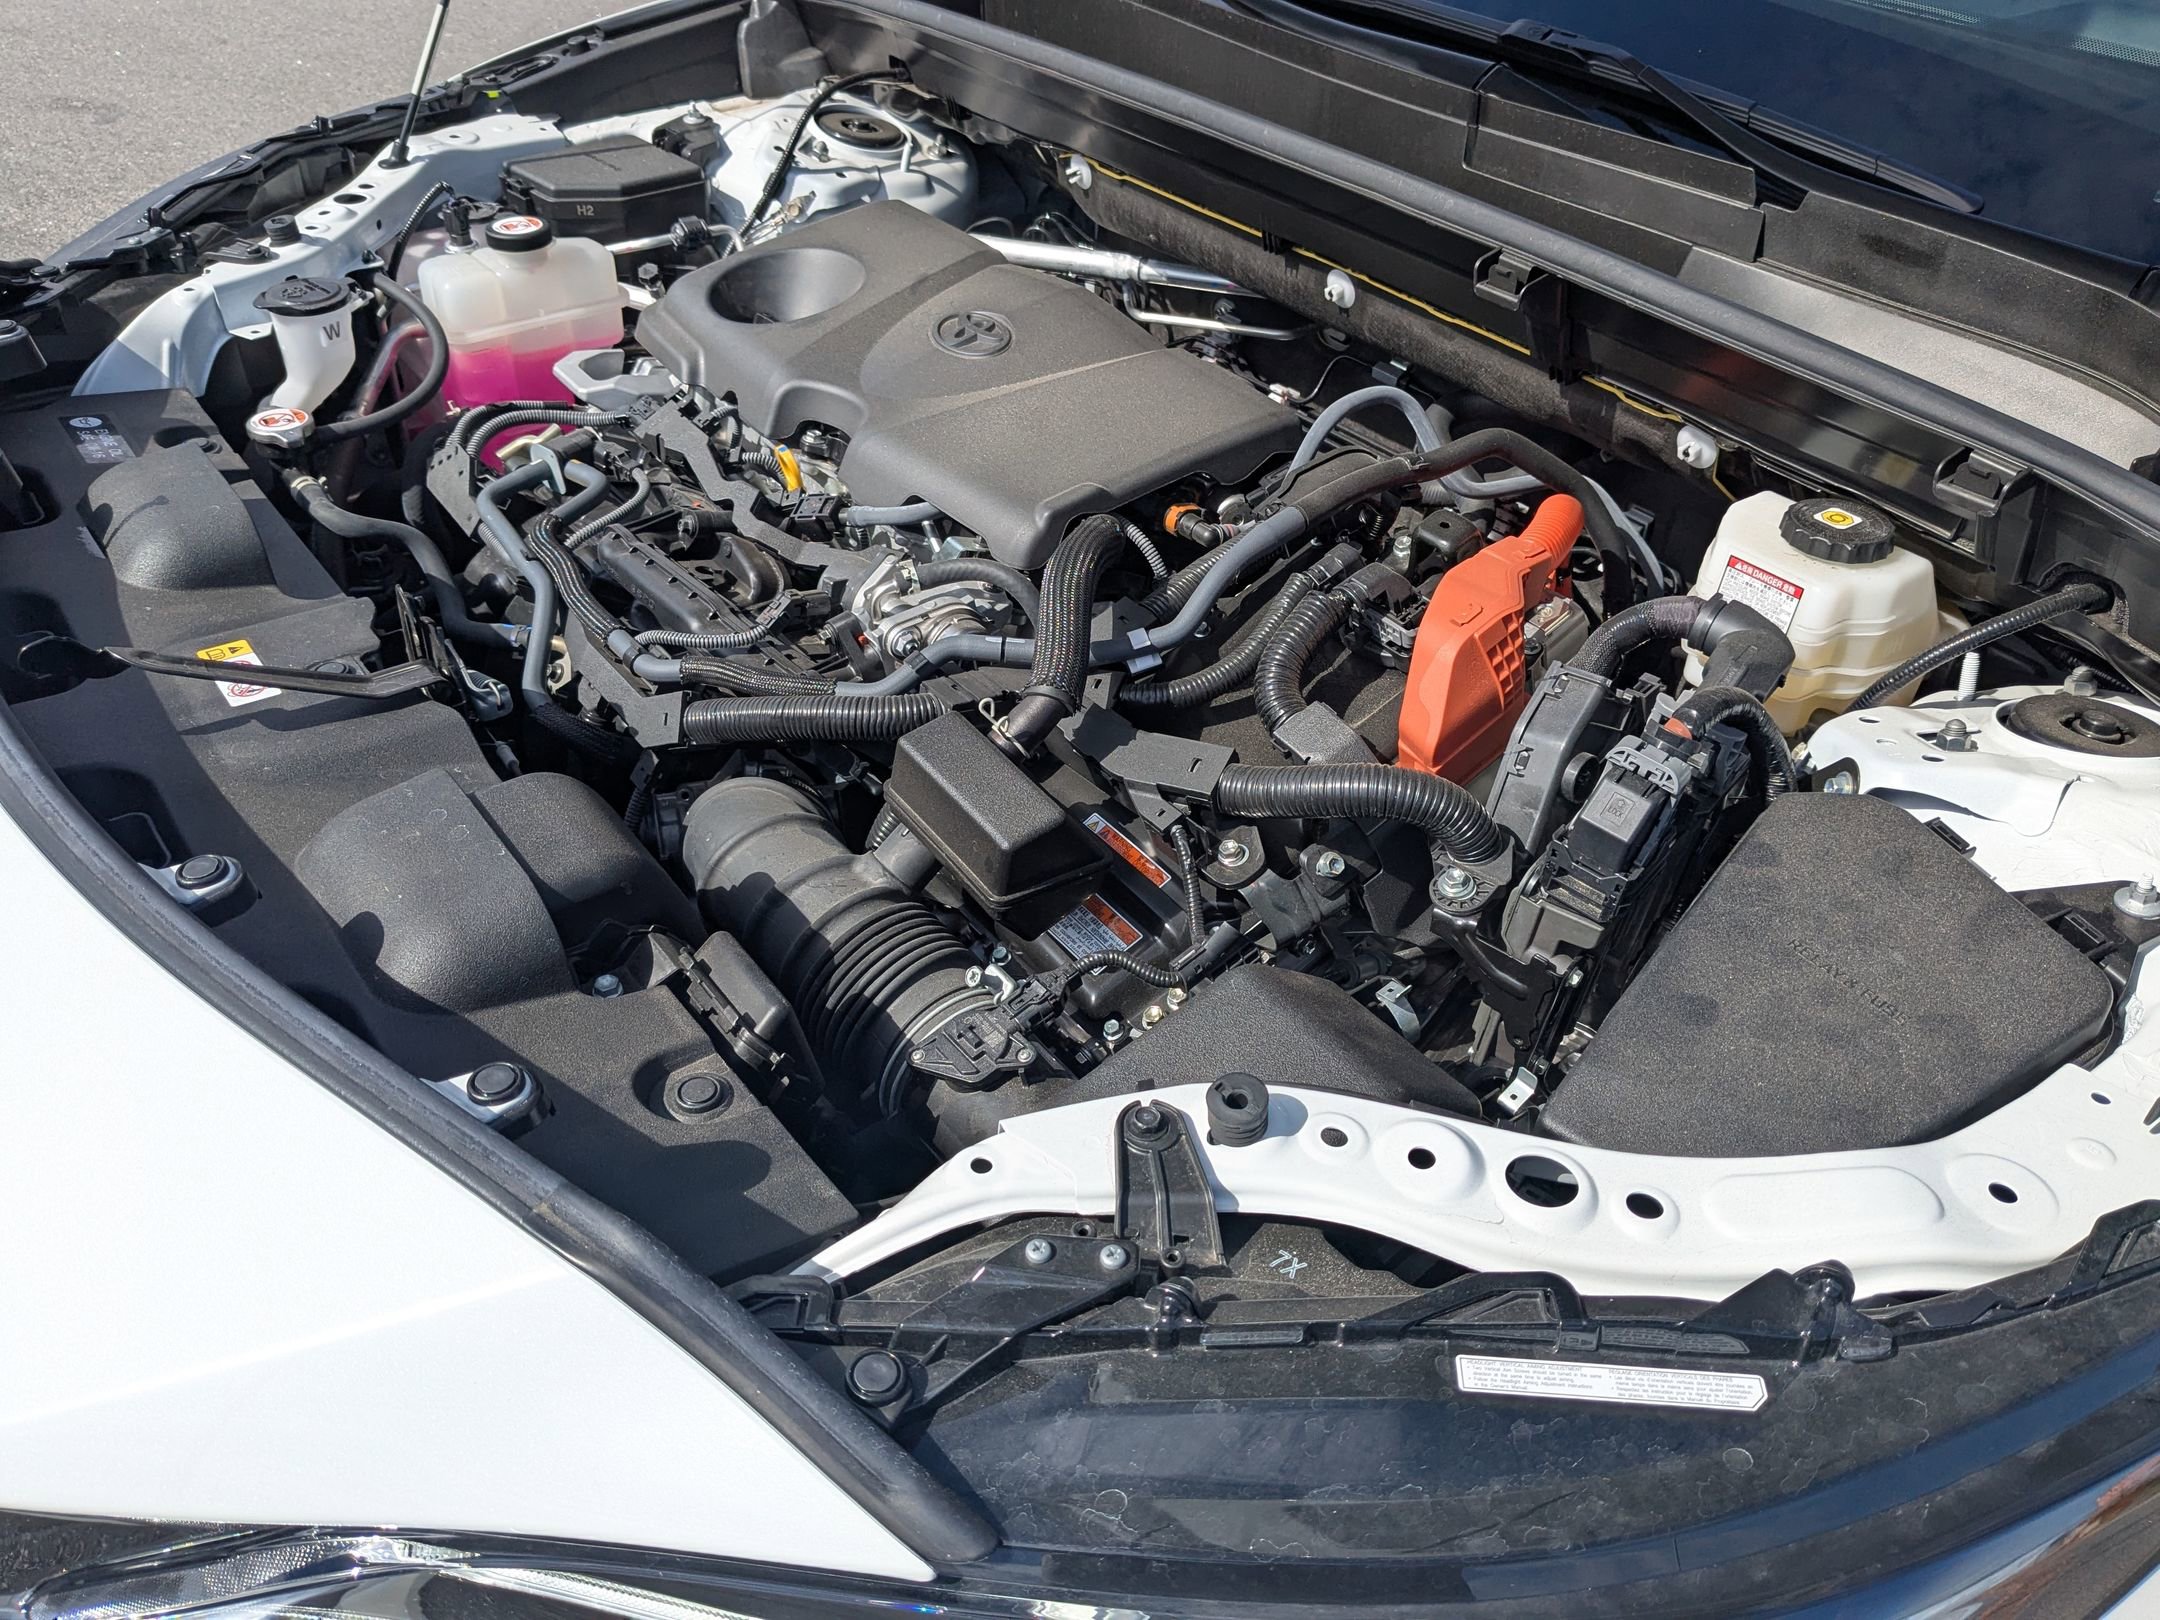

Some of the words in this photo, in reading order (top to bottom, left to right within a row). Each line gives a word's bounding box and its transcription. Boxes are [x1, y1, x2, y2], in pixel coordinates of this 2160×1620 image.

[576, 205, 595, 216] H2
[323, 321, 341, 341] W
[1753, 569, 1782, 589] DANGER
[1607, 806, 1624, 818] LOCK
[1787, 938, 1846, 979] RELAY
[1860, 988, 1911, 1025] FUSE
[1269, 1249, 1308, 1279] 7X
